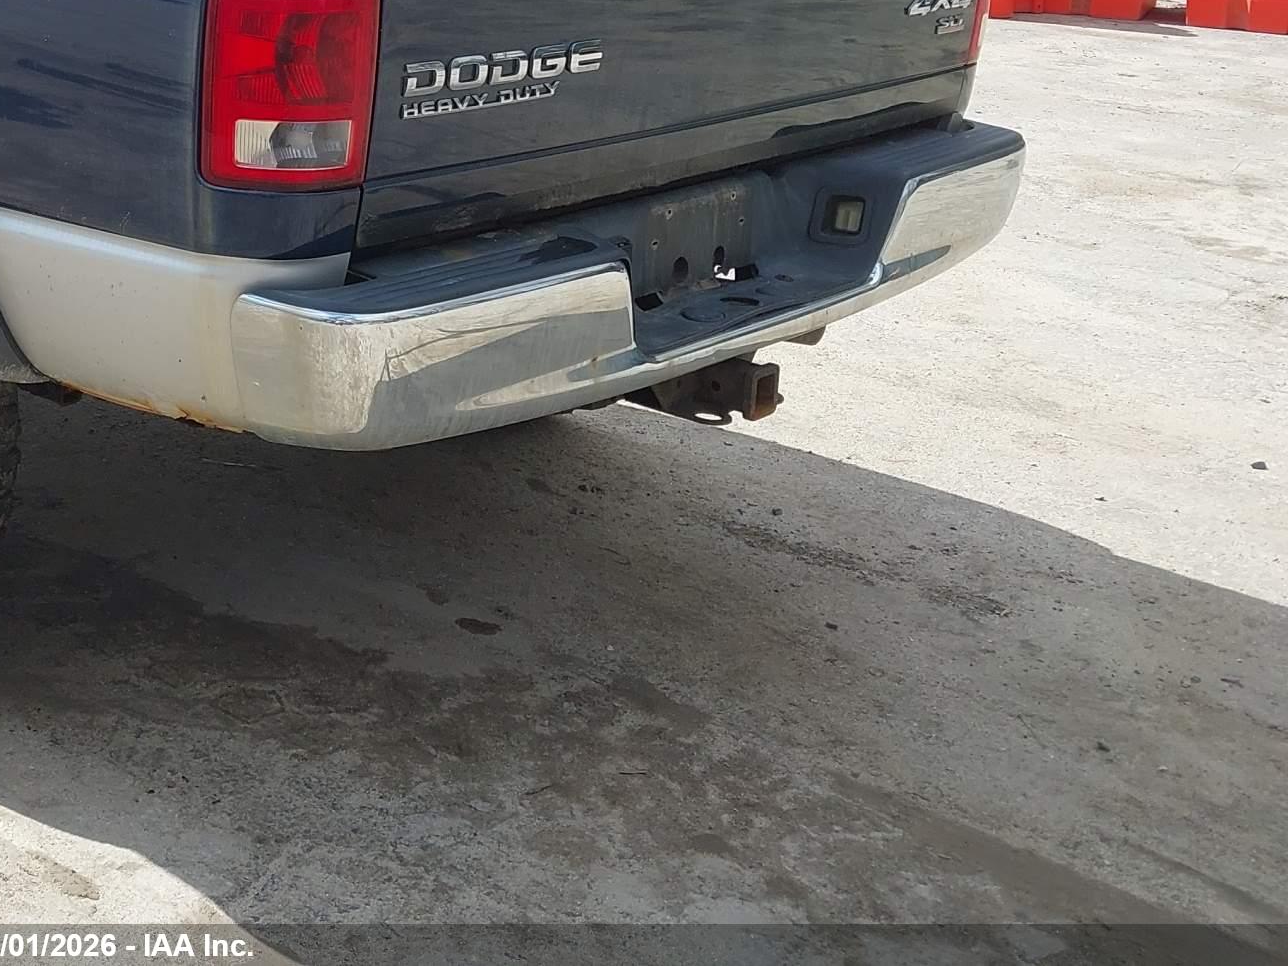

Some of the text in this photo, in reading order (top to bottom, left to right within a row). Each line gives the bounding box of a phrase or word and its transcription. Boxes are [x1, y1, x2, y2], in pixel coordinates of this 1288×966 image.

[402, 38, 604, 98] DODGE
[400, 80, 561, 120] HEAVY DUTY
